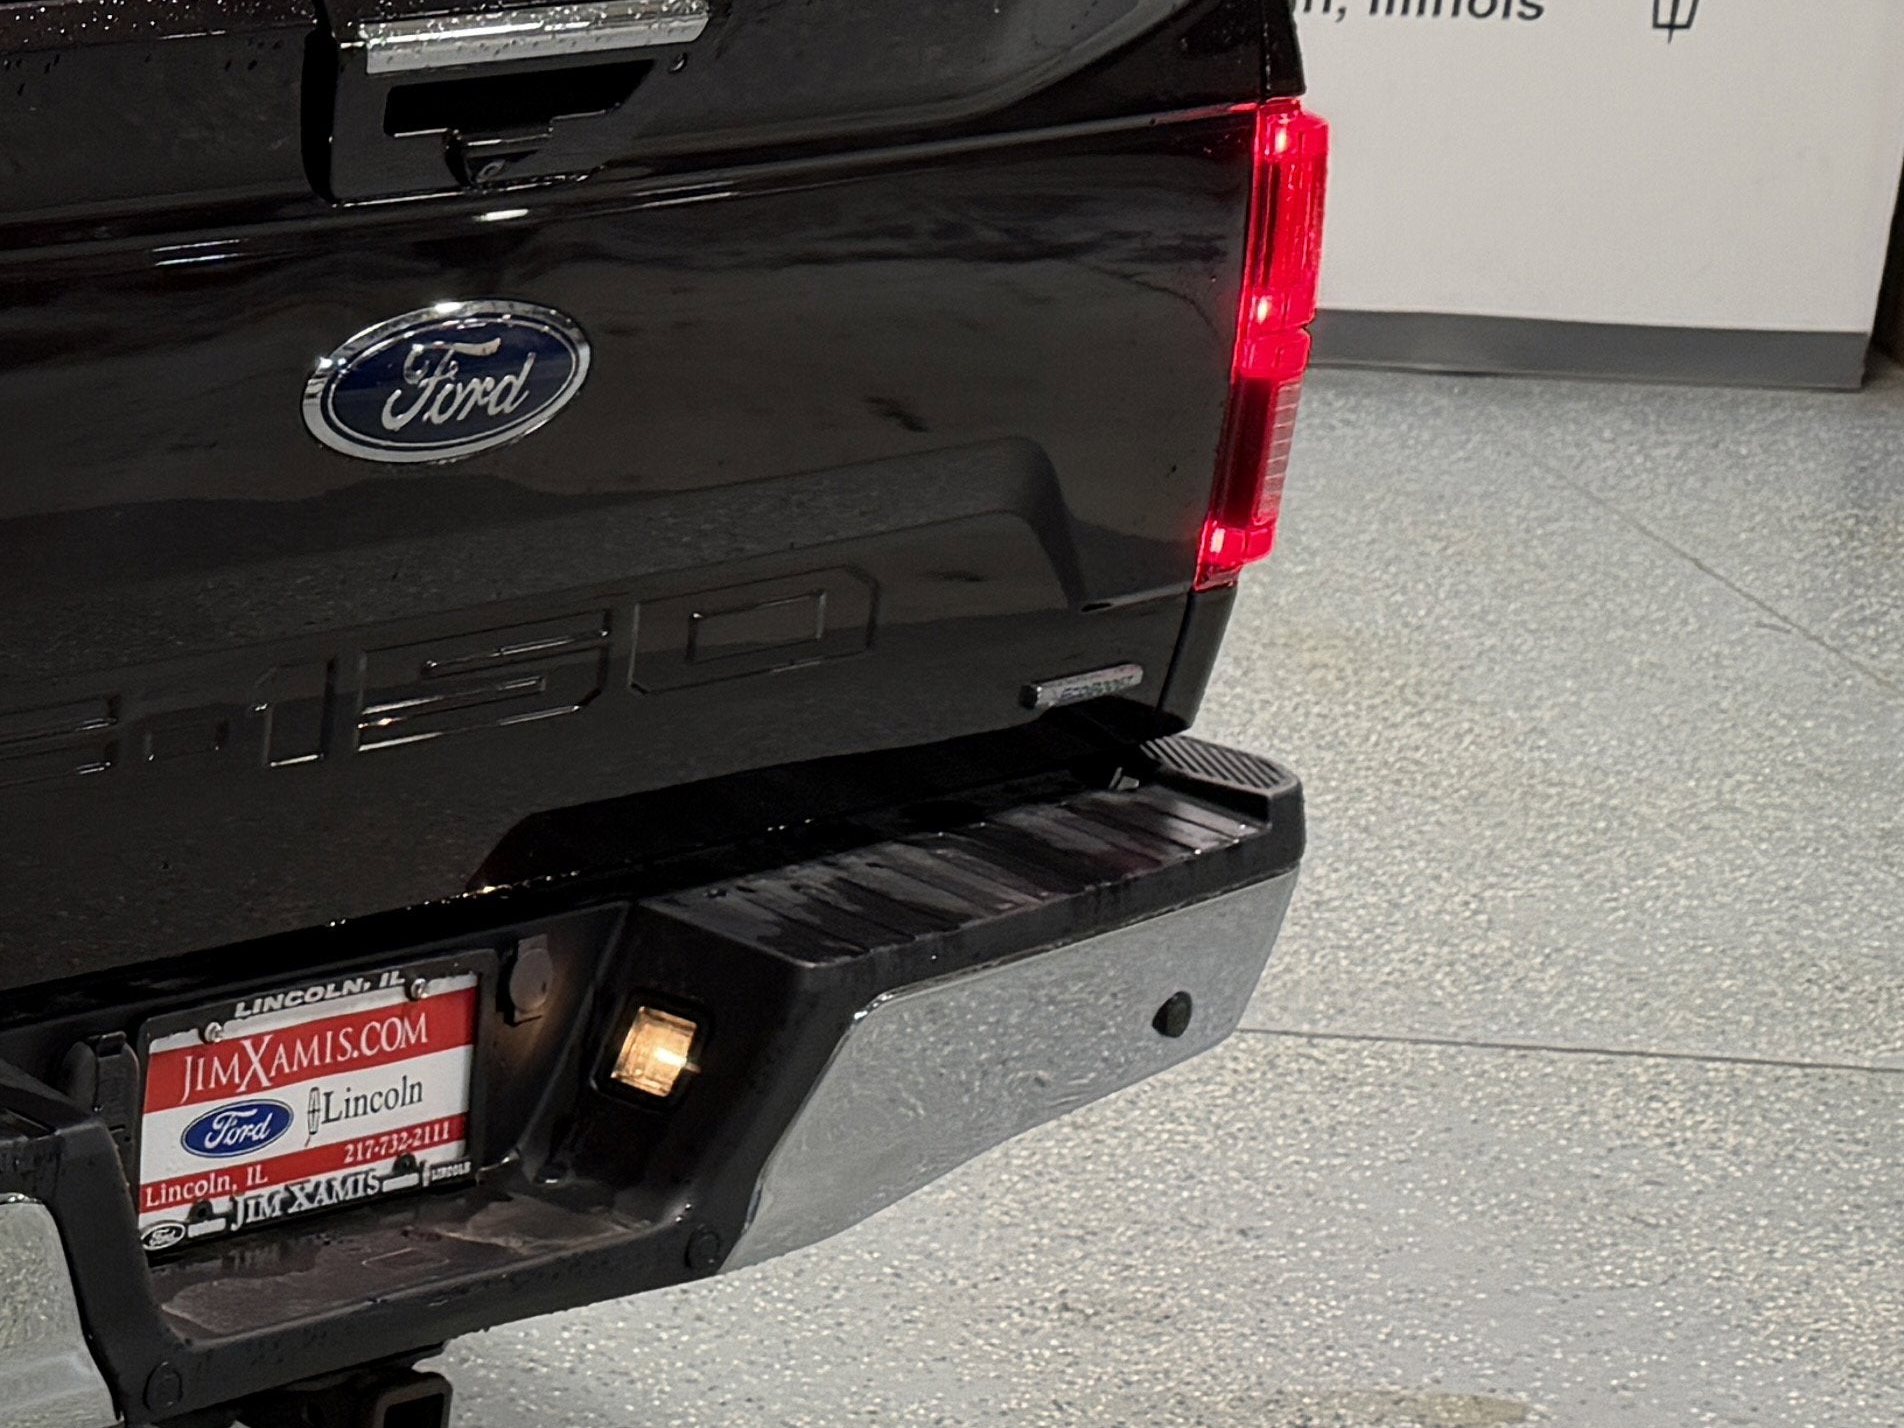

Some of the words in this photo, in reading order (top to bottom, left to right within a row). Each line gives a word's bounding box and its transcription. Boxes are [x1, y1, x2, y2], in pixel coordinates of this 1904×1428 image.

[381, 337, 537, 432] Ford
[234, 976, 371, 1019] LINCOLN,
[378, 969, 406, 988] IL
[180, 1012, 428, 1104] JIMXAMIS.COM
[320, 1075, 423, 1125] Lincoln
[204, 1109, 274, 1150] Ford
[343, 1121, 451, 1164] 217-732-2111
[145, 1170, 238, 1208] Lincoln,
[245, 1165, 269, 1188] IL
[230, 1196, 282, 1231] JIM
[288, 1170, 382, 1214] XAMIS
